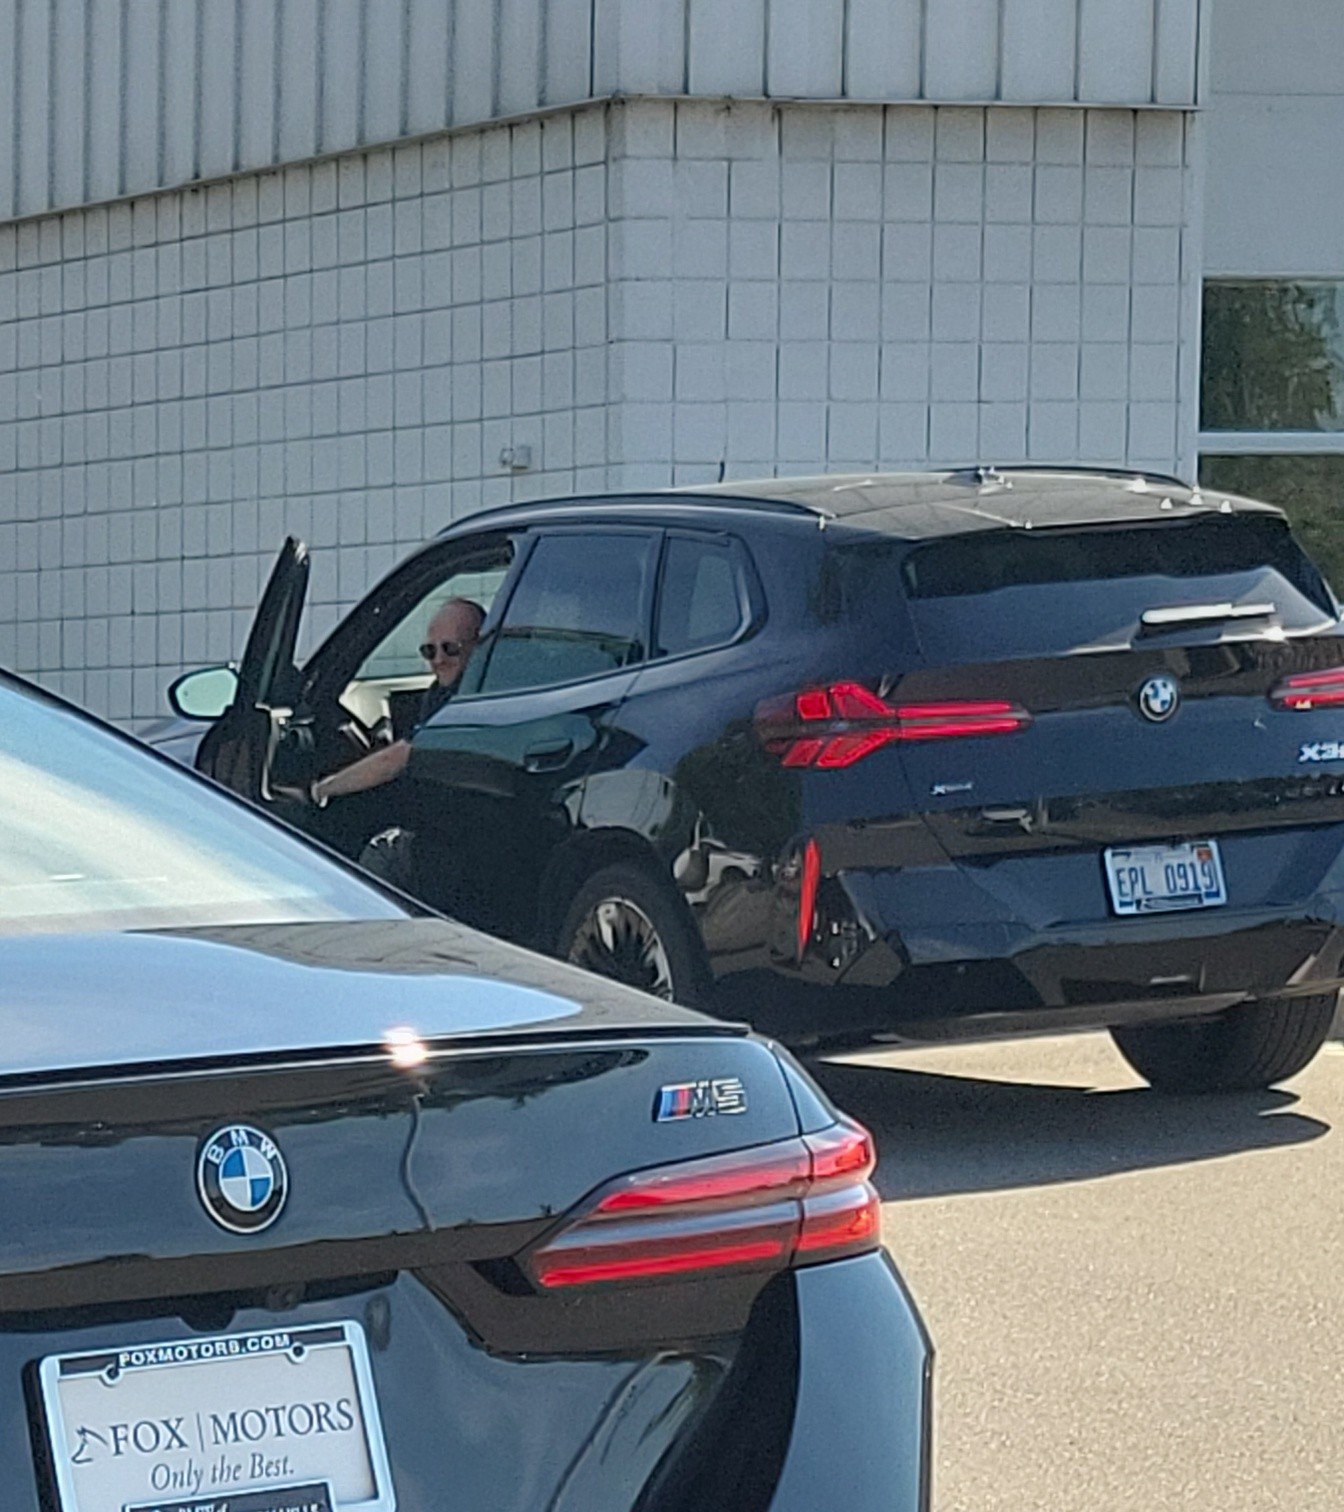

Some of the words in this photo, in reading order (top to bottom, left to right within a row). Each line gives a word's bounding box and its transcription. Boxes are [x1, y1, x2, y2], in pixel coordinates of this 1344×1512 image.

[1116, 866, 1154, 898] EPL
[1164, 861, 1215, 894] 0919
[207, 1128, 277, 1164] BMW
[118, 1334, 291, 1367] FOXMOTORS.COM
[109, 1416, 189, 1457] FOX
[211, 1398, 355, 1446] MOTORS
[150, 1461, 204, 1496] Only
[211, 1455, 242, 1484] the
[249, 1452, 295, 1480] Best.
